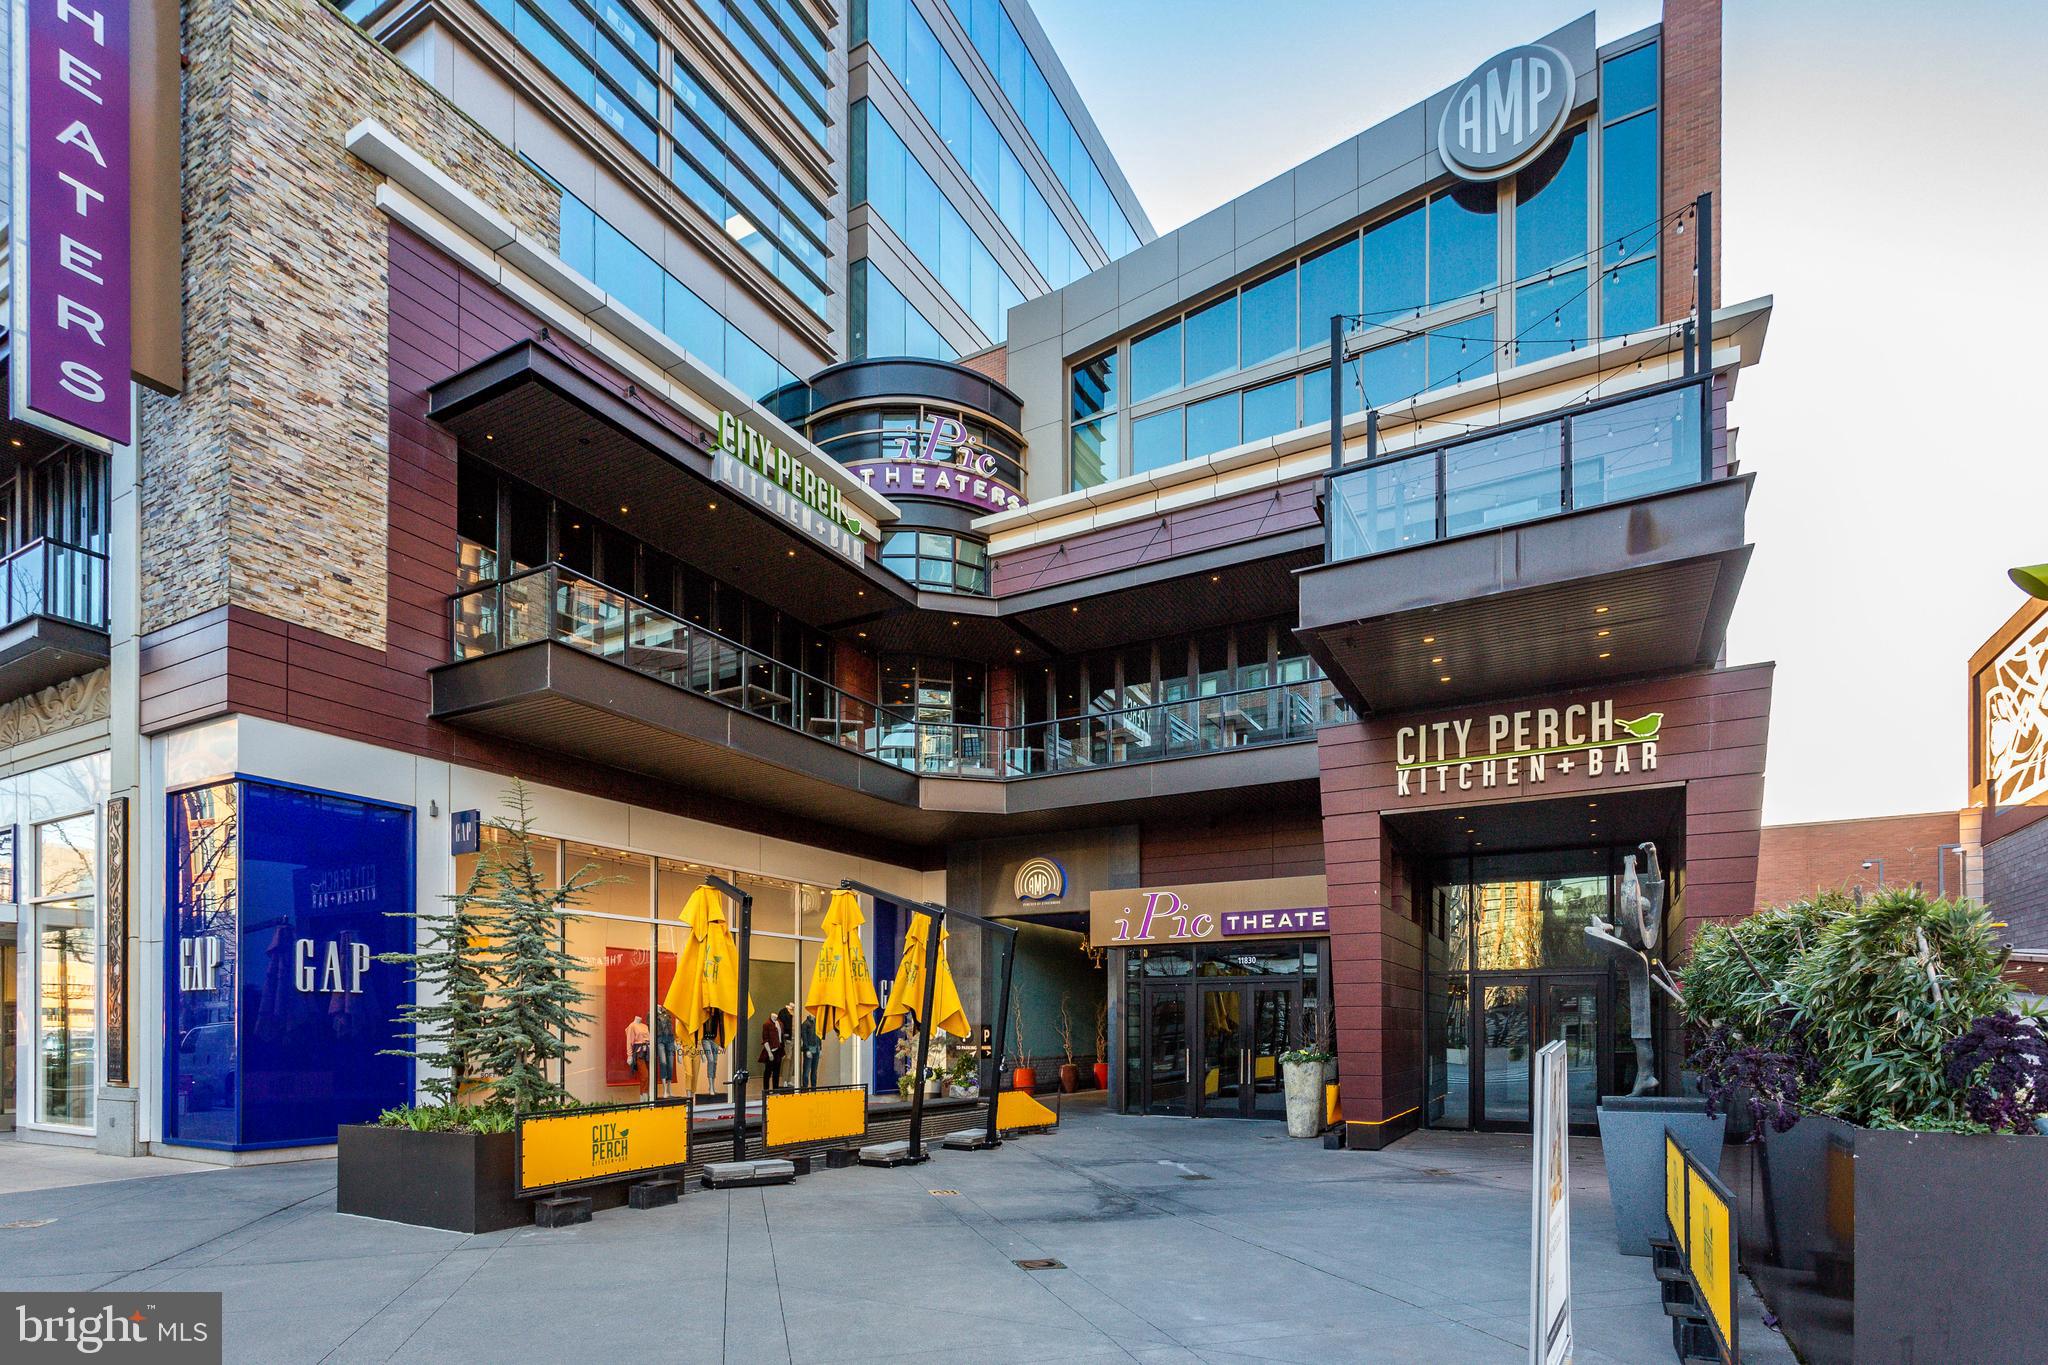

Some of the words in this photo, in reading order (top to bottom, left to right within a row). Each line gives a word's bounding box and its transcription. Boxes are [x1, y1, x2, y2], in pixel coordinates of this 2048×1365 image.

[1458, 57, 1552, 154] AMP
[718, 410, 772, 476] CITY
[775, 447, 842, 525] PERCH
[891, 413, 998, 478] iPic
[722, 455, 812, 532] KITCHEN
[830, 525, 862, 562] BAR
[859, 467, 1021, 511] THEATERS
[1396, 718, 1473, 766] CITY
[1489, 699, 1613, 755] PERCH
[1397, 754, 1545, 797] KITCHEN
[1557, 757, 1575, 774] +
[1588, 742, 1658, 777] BAR
[455, 822, 471, 842] GAP
[1028, 874, 1047, 896] AMP
[1111, 891, 1214, 941] iPic
[1226, 911, 1326, 930] THEATE
[179, 936, 219, 991] GAP
[295, 938, 370, 993] GAP
[1237, 956, 1257, 965] 11830
[983, 1029, 990, 1042] P
[592, 1123, 617, 1143] CITY
[592, 1139, 629, 1161] PERCH
